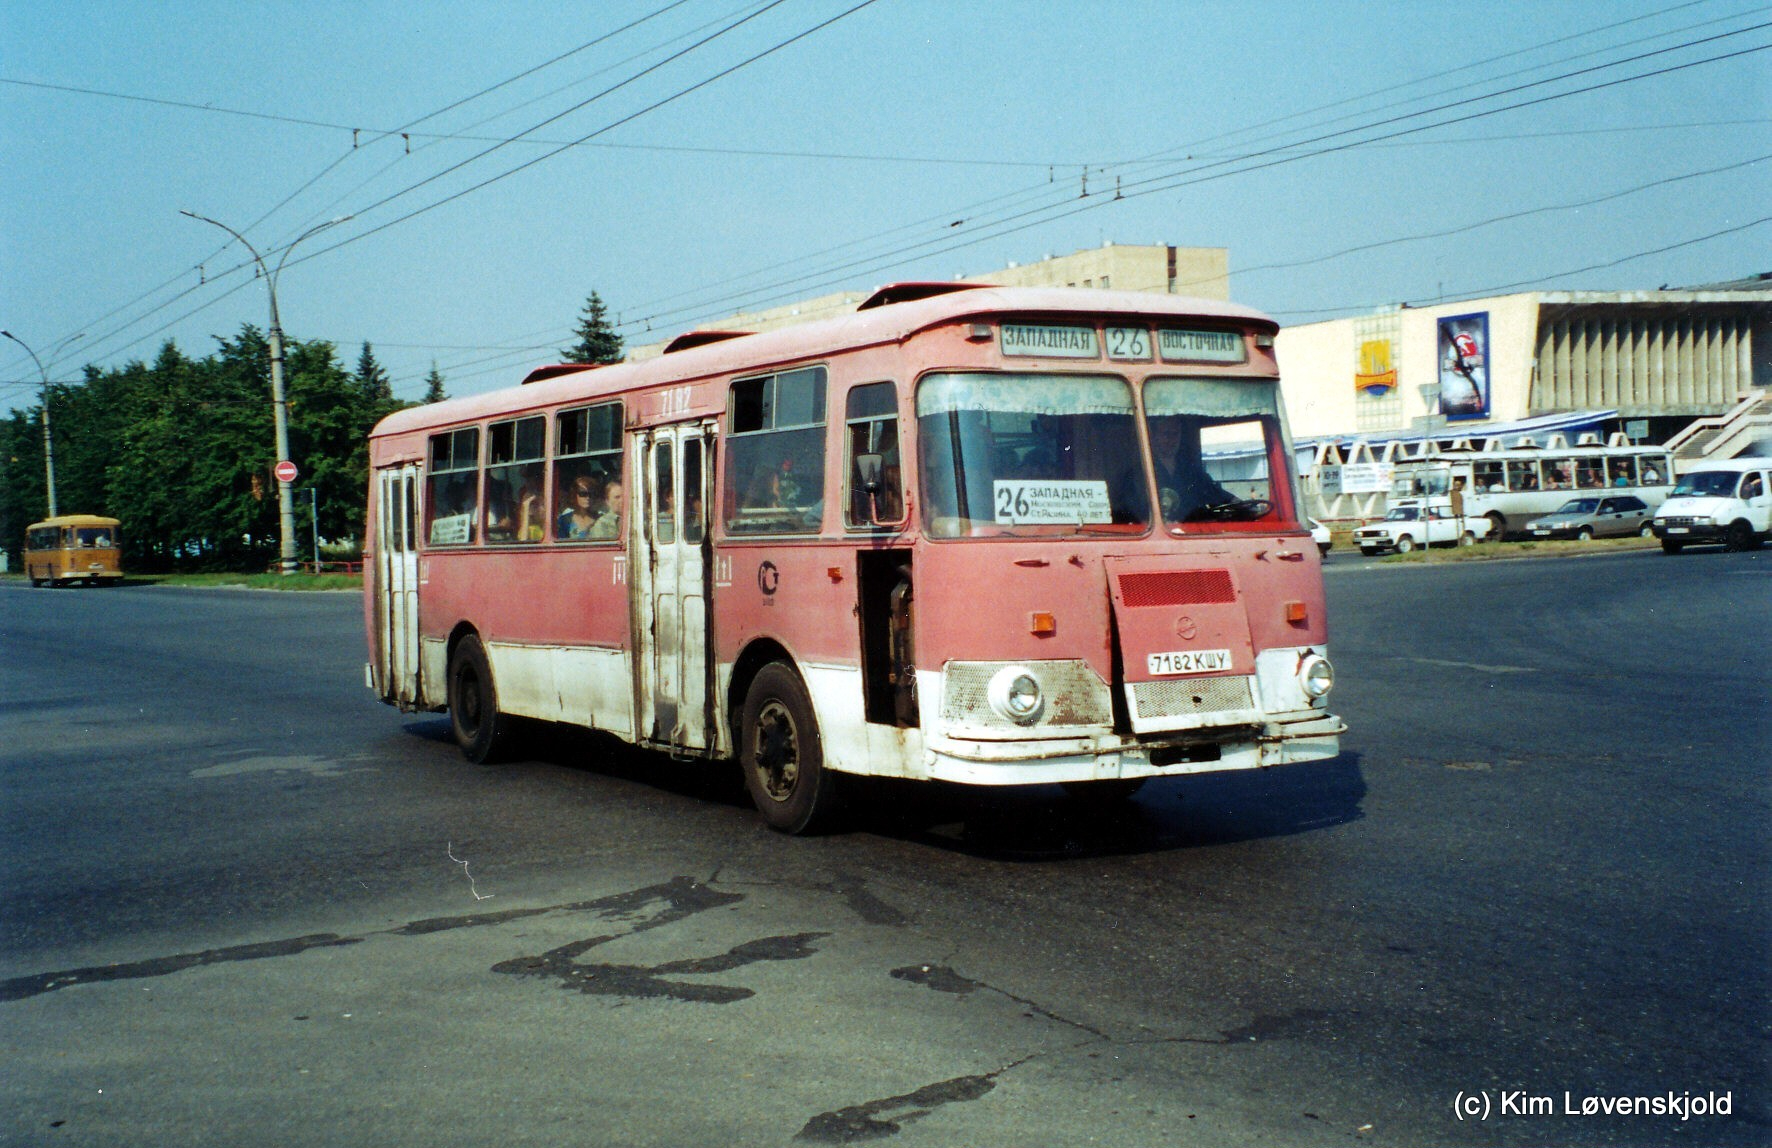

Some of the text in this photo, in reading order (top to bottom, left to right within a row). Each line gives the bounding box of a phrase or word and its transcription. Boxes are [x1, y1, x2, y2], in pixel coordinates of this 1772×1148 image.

[1005, 327, 1090, 350] ЗАПАДНАЯ
[1112, 329, 1143, 355] 26
[1162, 331, 1235, 352] ВОСТОЧНАЯ
[998, 487, 1030, 517] 26
[1030, 488, 1094, 500] ЗАПАДНАЯ
